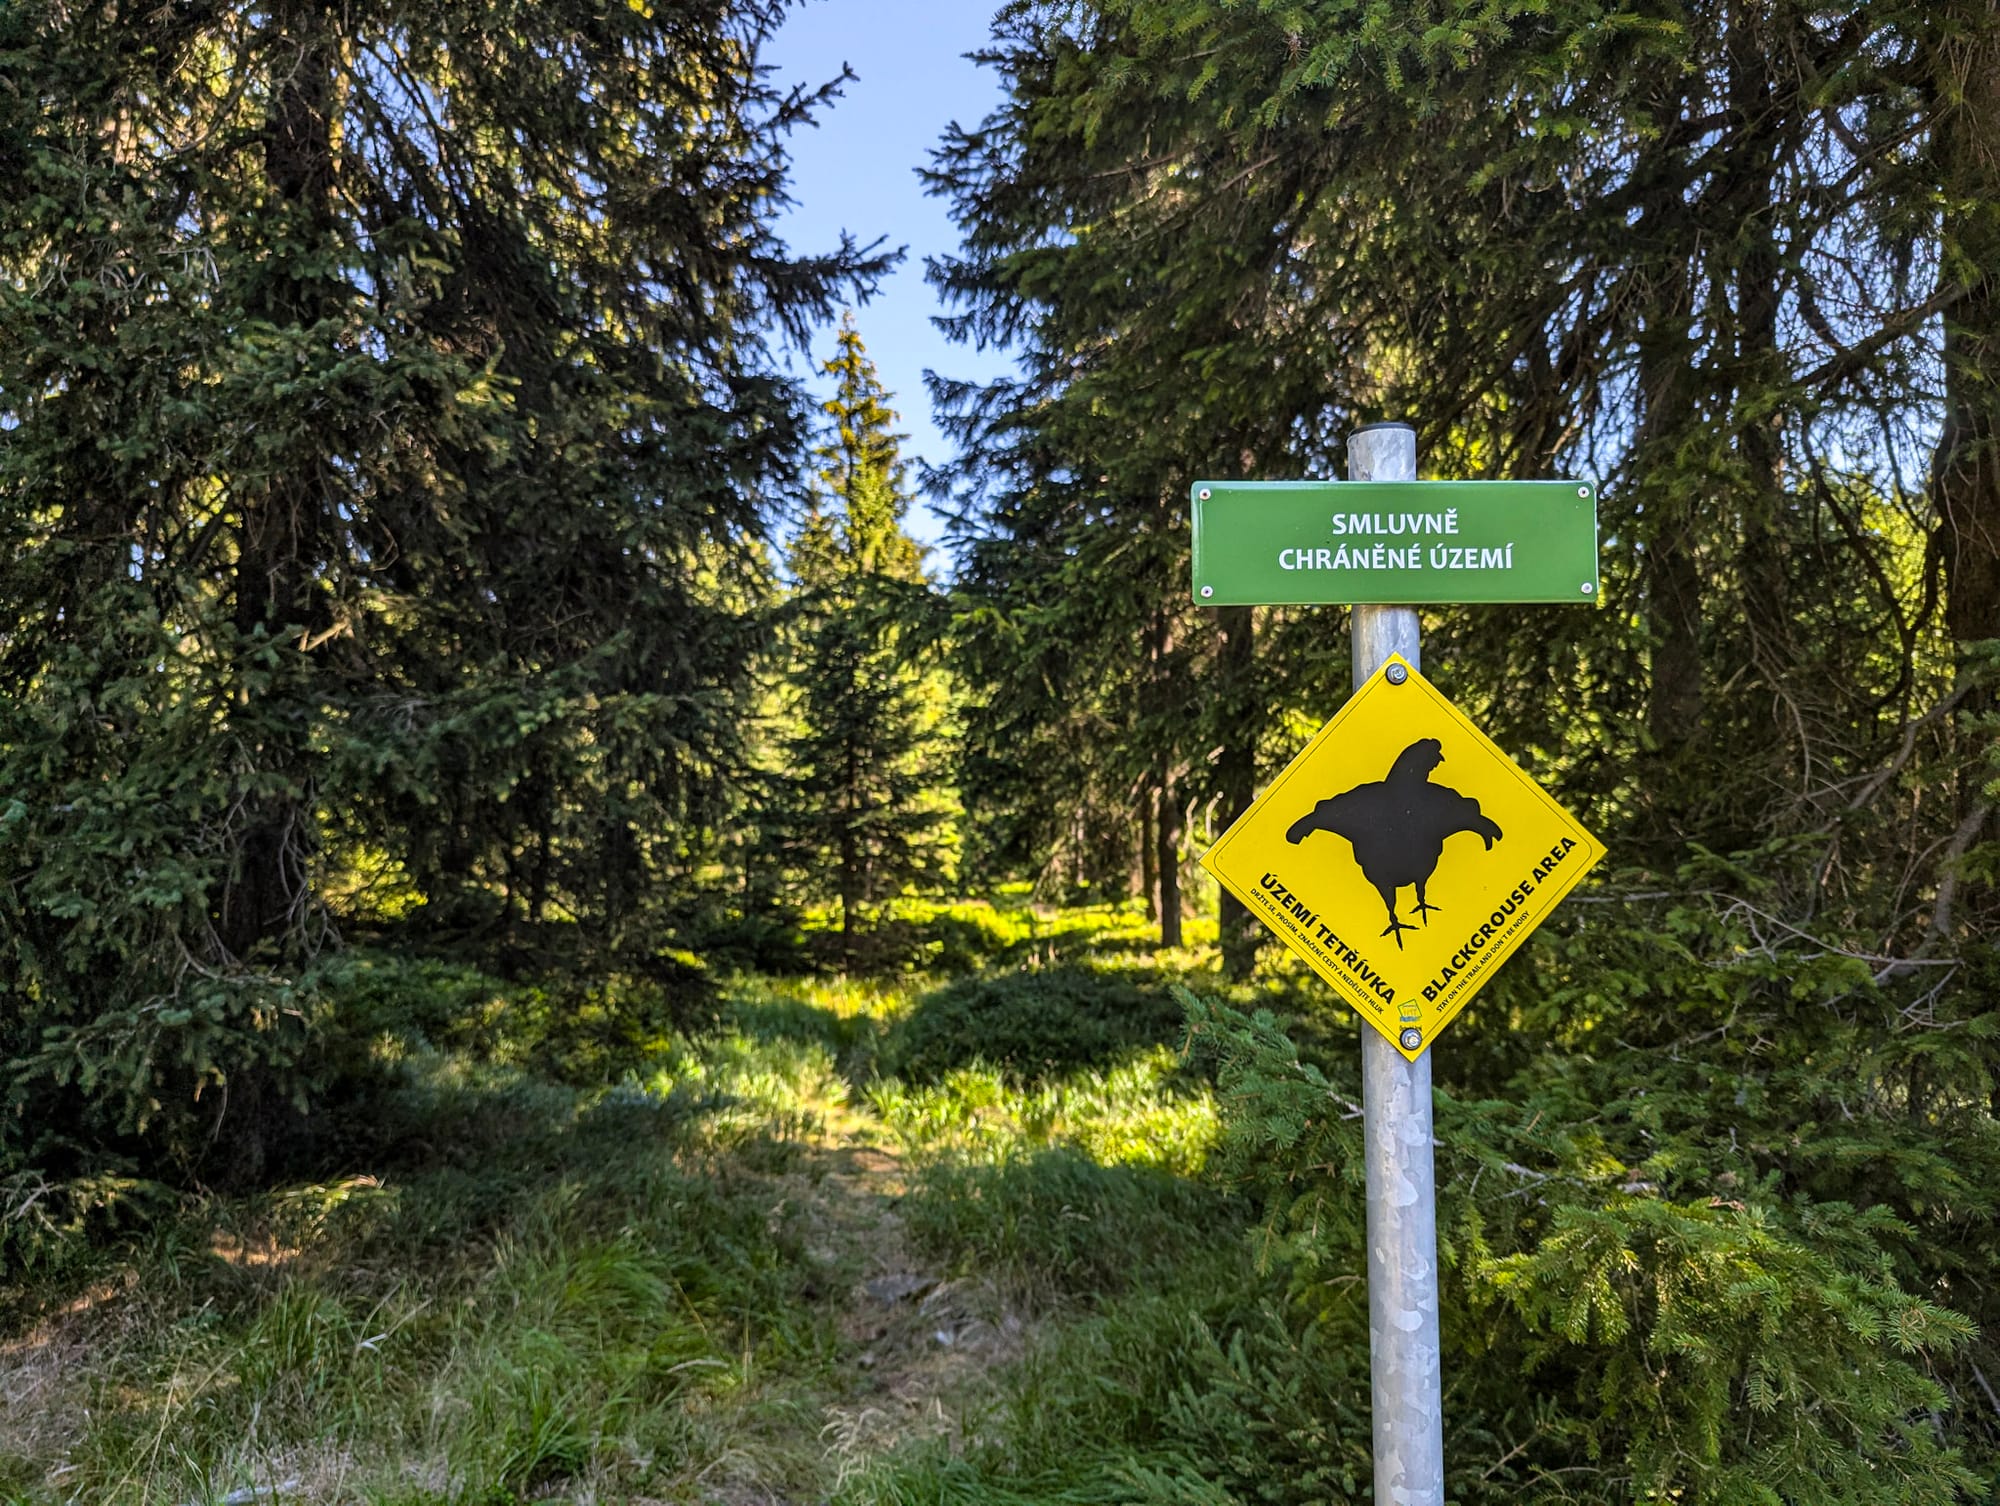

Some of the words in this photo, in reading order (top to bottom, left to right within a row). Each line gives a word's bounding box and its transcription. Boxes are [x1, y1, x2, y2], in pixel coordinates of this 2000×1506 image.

[1278, 543, 1422, 570] CHRÁNĚNÉ
[1430, 542, 1513, 569] ÚZEMÍ
[1332, 508, 1459, 535] SMLUVNĚ
[1250, 887, 1270, 907] DRŽTE
[1322, 955, 1341, 972] CESTY
[1368, 998, 1384, 1015] HLUK
[1260, 872, 1320, 929] ÚZEMÍ
[1316, 923, 1396, 1005] TETŘÍVKA
[1421, 880, 1535, 1003] BLACKGROUSE
[1532, 837, 1577, 884] AREA
[1436, 998, 1450, 1013] STAY
[1447, 989, 1458, 1000] ON
[1455, 978, 1468, 991] THE
[1465, 964, 1482, 981] TRAIL
[1479, 951, 1493, 966] AND
[1506, 926, 1516, 937] BE
[1513, 910, 1530, 929] NOISY
